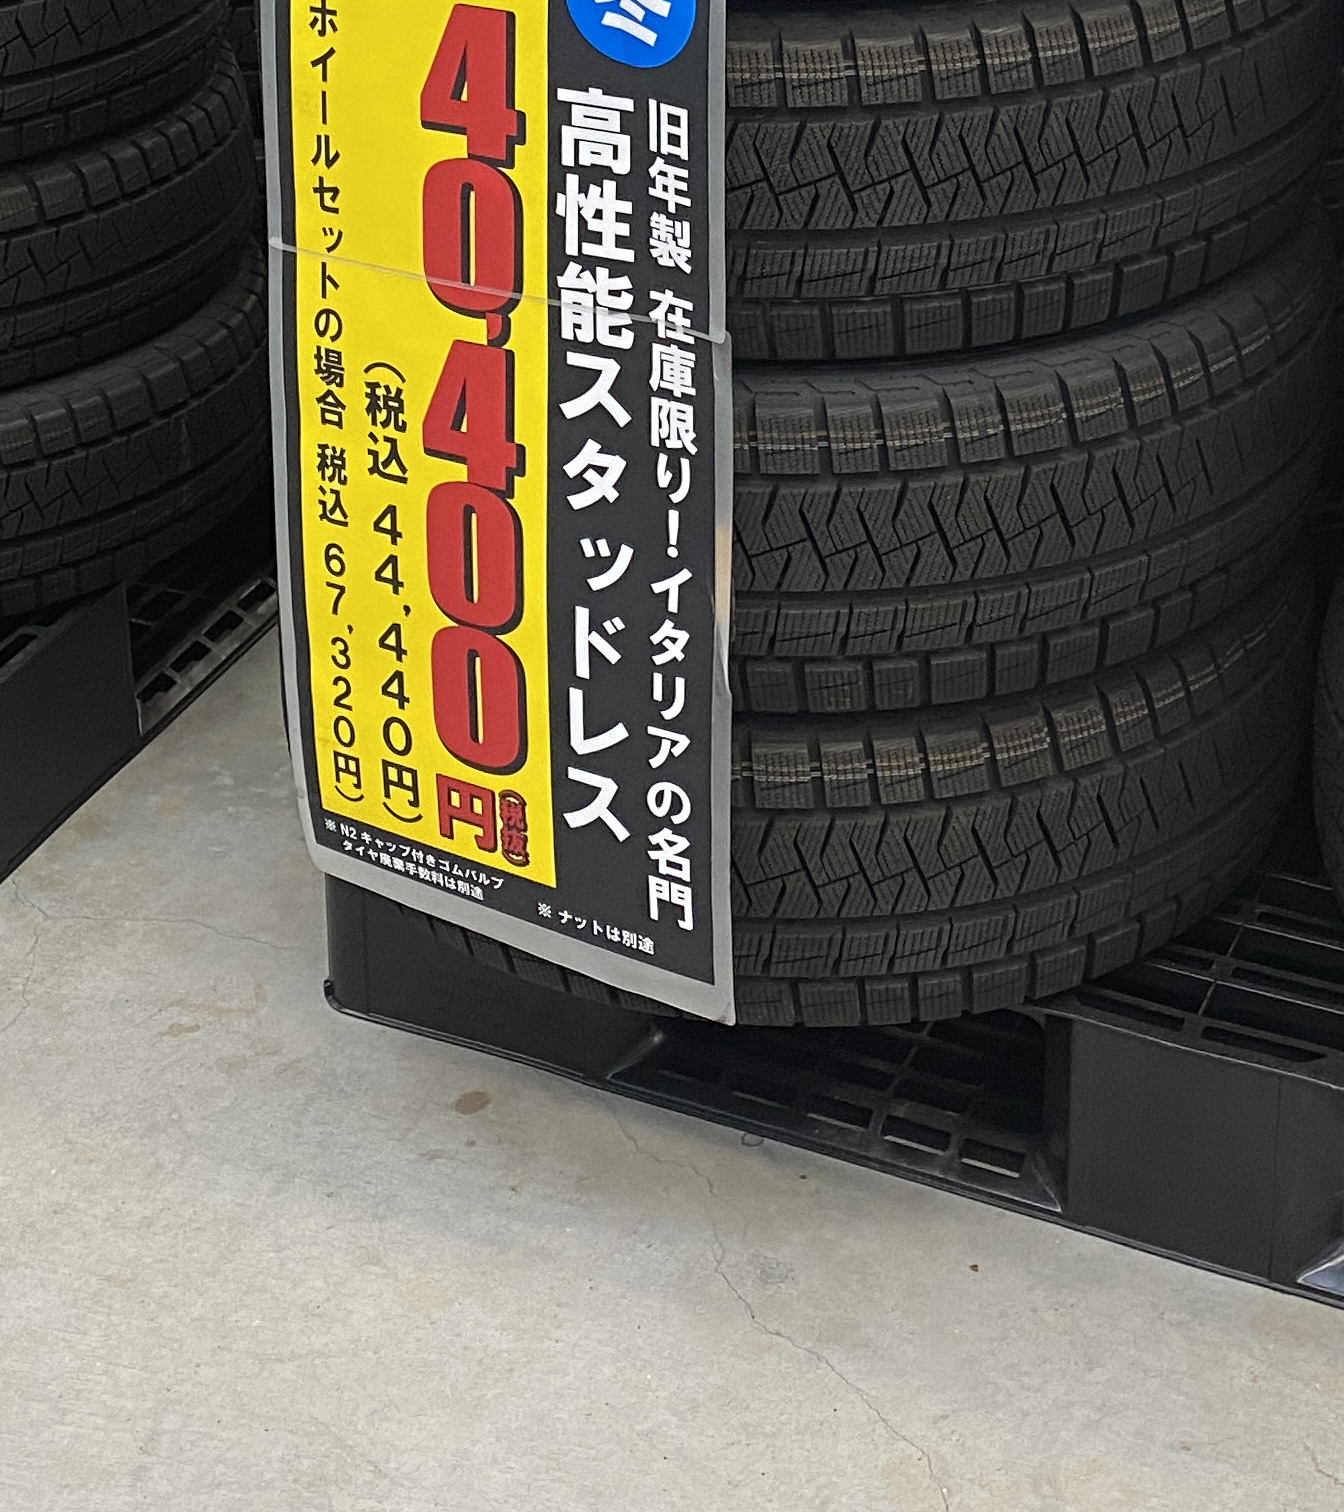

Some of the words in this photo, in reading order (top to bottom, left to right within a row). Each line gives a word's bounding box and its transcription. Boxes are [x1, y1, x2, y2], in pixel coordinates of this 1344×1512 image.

[645, 96, 694, 275] 旧年製
[554, 86, 635, 844] 高性能スタッドレス
[557, 908, 656, 956] ナットは別途
